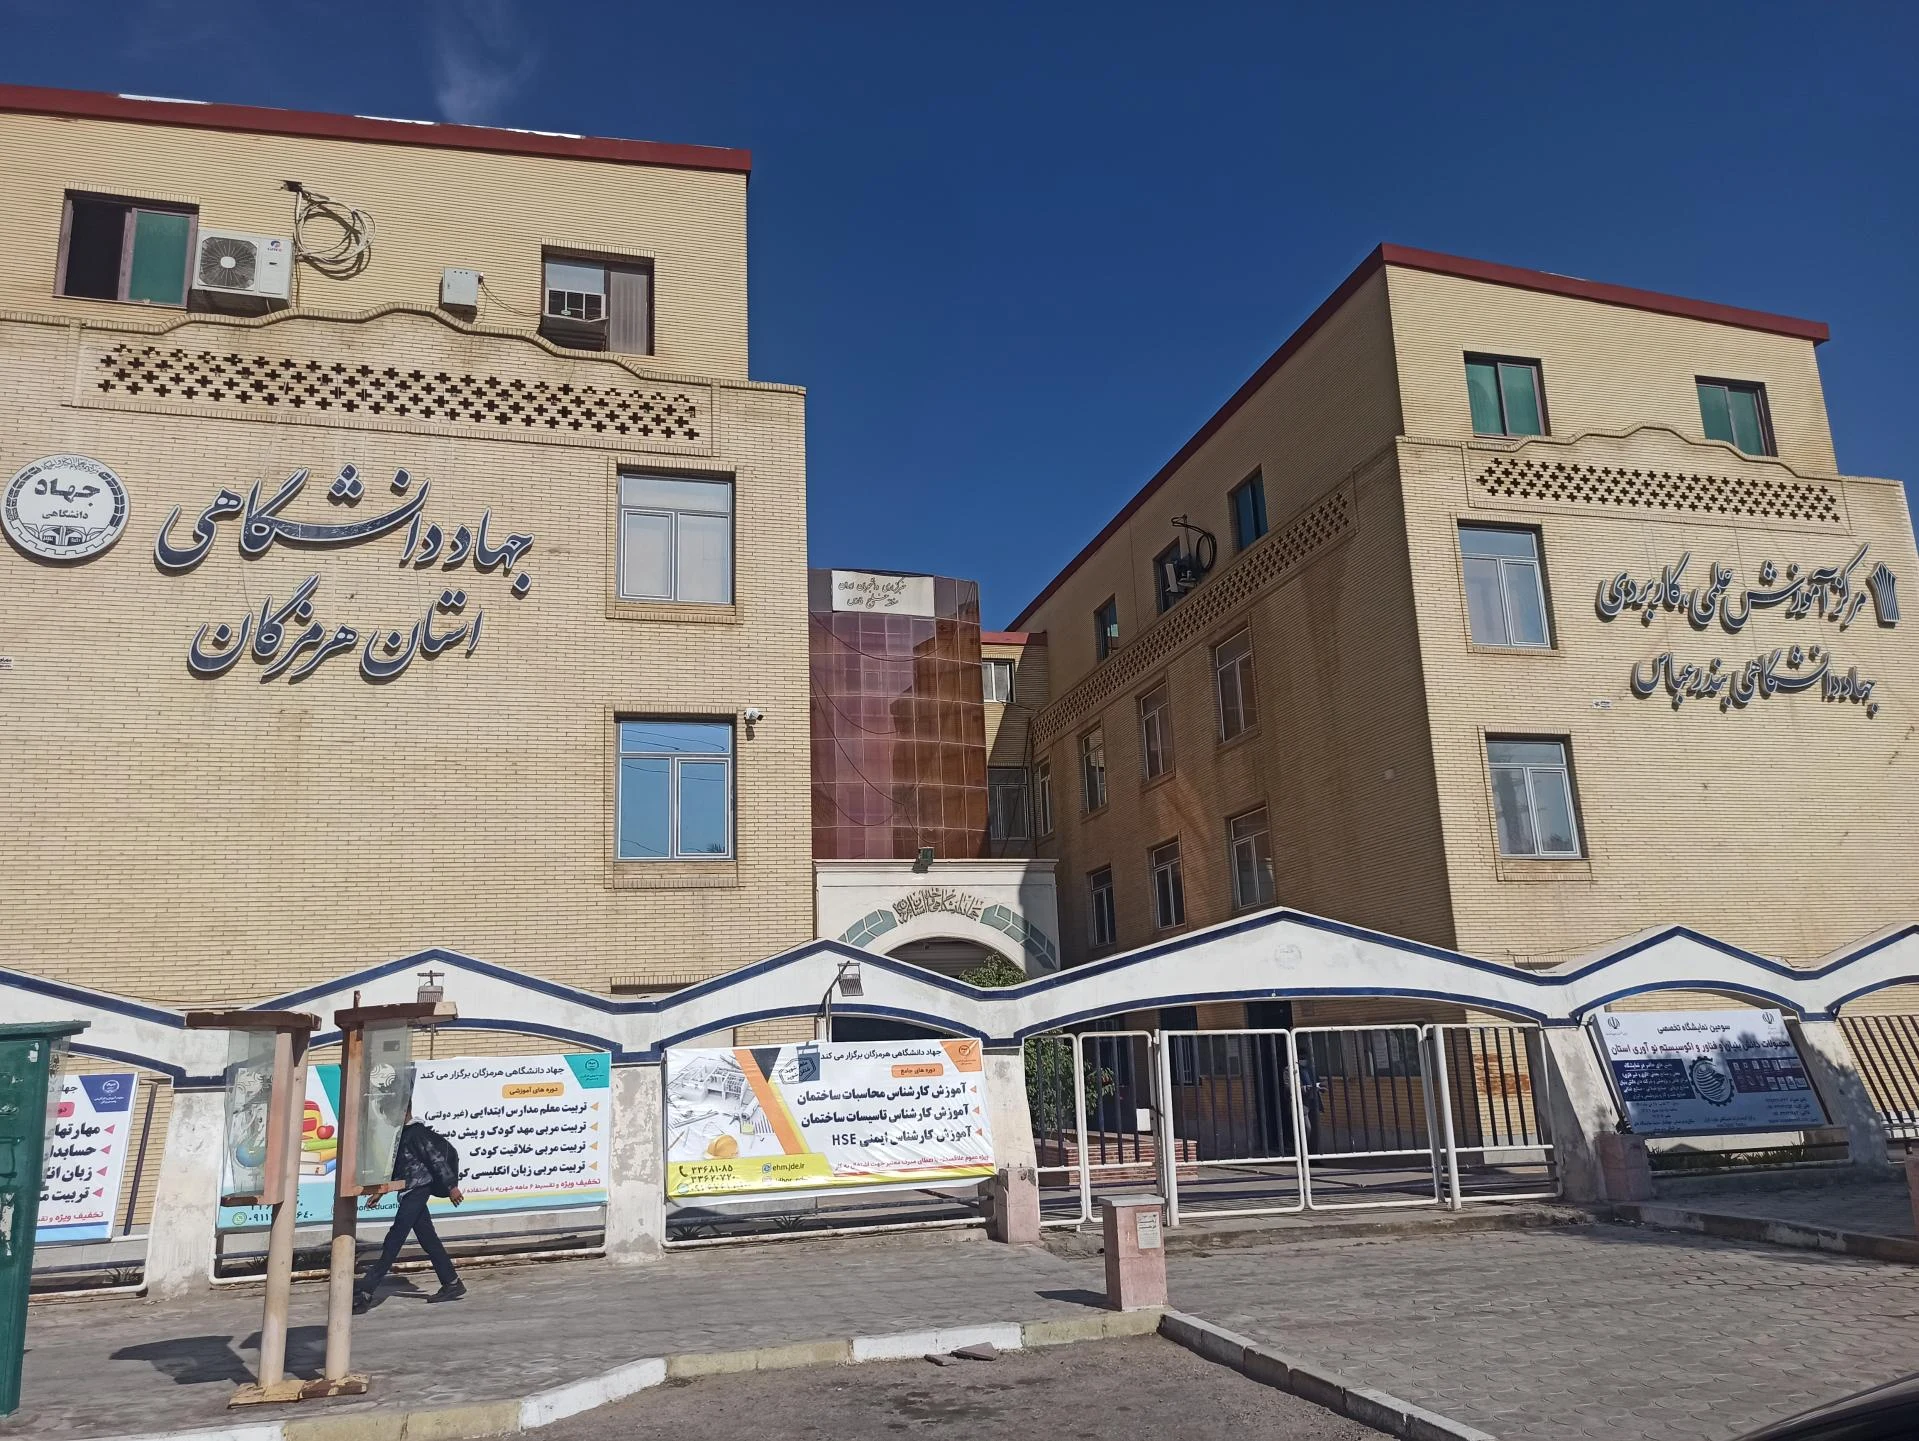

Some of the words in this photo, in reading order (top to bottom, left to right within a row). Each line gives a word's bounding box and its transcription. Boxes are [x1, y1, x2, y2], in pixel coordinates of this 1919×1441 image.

[35, 478, 100, 507] جهاد
[42, 509, 88, 519] دانشگاهی
[153, 463, 444, 569] دانشگاهی
[442, 506, 536, 593] جهاد
[1828, 542, 1871, 626] مرکز
[1724, 559, 1839, 629] آموزش
[187, 572, 359, 682] هرمزگان
[360, 588, 485, 677] استان
[1731, 644, 1843, 704] دانشگاهی
[1843, 666, 1880, 715] جهاد
[1657, 1024, 1681, 1034] تخصصی
[1682, 1021, 1708, 1033] نمایشگاه
[891, 1049, 925, 1059] دانشگاهی
[925, 1049, 942, 1058] جهاد
[1611, 1044, 1631, 1055] استان
[1659, 1042, 1694, 1054] اکوسیستم
[1695, 1044, 1701, 1053] و
[821, 1052, 833, 1060] کند
[845, 1051, 863, 1061] برگزار
[864, 1050, 891, 1060] هرمزگان
[420, 1071, 435, 1079] کند
[450, 1069, 471, 1080] برگزار
[472, 1068, 504, 1079] هرمزگان
[505, 1066, 545, 1078] دانشگاهی
[546, 1066, 564, 1075] جهاد
[900, 1067, 913, 1075] جامع
[914, 1066, 924, 1074] های
[509, 1086, 532, 1096] آموزشی
[843, 1087, 886, 1102] محاسبات
[886, 1085, 930, 1101] کارشناس
[932, 1082, 967, 1098] آموزش
[797, 1089, 841, 1105] ساختمان
[470, 1106, 505, 1119] ابتدایی
[506, 1105, 538, 1117] مدارس
[540, 1104, 560, 1116] معلم
[562, 1101, 588, 1114] تربیت
[934, 1104, 969, 1120] آموزش
[801, 1113, 845, 1127] ساختمان
[846, 1110, 887, 1124] تاسیسات
[888, 1107, 932, 1123] کارشناس
[458, 1127, 478, 1140] پیش
[487, 1125, 515, 1137] کودک
[517, 1125, 534, 1135] مهد
[535, 1123, 559, 1135] مربی
[561, 1121, 587, 1134] تربیت
[479, 1130, 485, 1139] و
[832, 1133, 857, 1146] HSE
[936, 1126, 972, 1143] آموزش
[469, 1146, 498, 1159] کودک
[500, 1144, 533, 1157] خلاقیت
[535, 1143, 558, 1156] مربی
[560, 1141, 586, 1153] تربیت
[62, 1164, 93, 1182] زبان
[471, 1165, 510, 1180] انگلیسی
[511, 1164, 532, 1177] زبان
[533, 1163, 557, 1176] مربی
[559, 1161, 586, 1174] تربیت
[457, 1168, 470, 1181] کو
[495, 1184, 514, 1193] شهریه
[560, 1181, 574, 1189] ویژه
[576, 1178, 601, 1186] تخفیف
[51, 1187, 90, 1203] تربیت
[55, 1214, 71, 1222] ویژه
[73, 1211, 104, 1220] تخفیف
